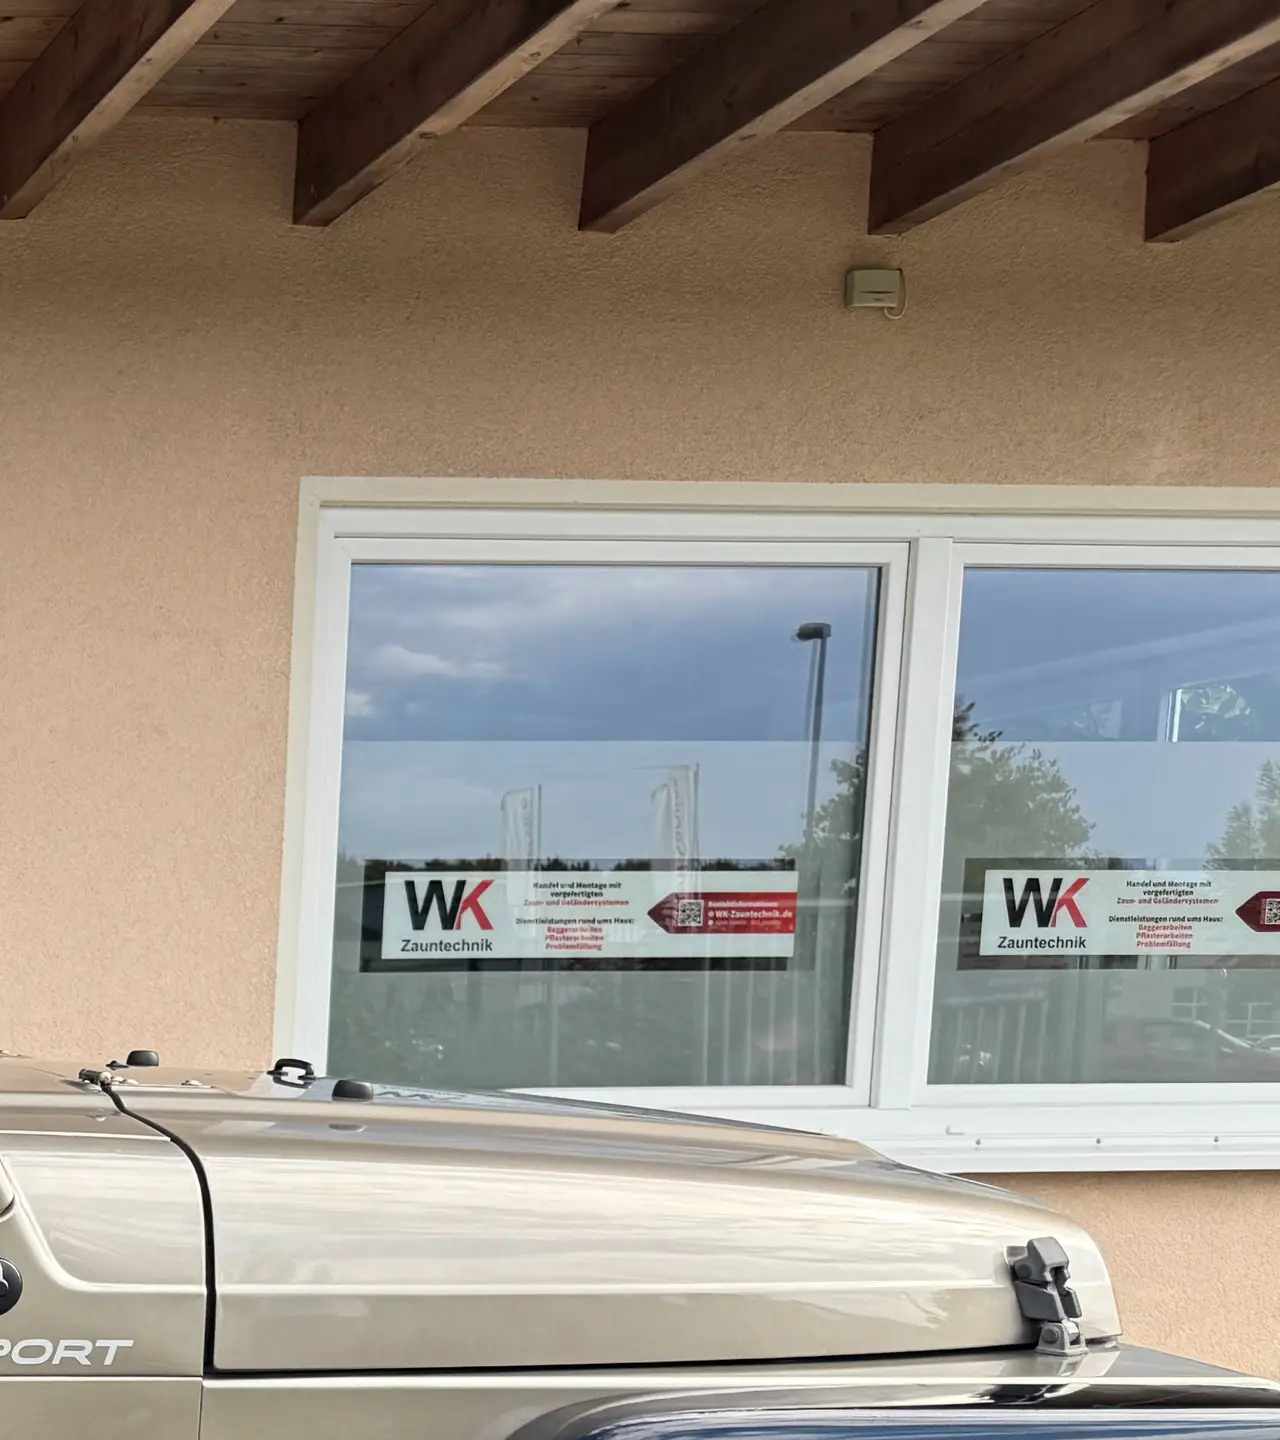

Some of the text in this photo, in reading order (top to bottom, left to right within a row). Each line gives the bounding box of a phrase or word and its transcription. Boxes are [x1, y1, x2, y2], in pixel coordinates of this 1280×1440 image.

[1199, 880, 1212, 888] mit
[404, 879, 495, 931] WK
[1002, 877, 1091, 928] WK
[401, 937, 493, 952] Zauntechnik
[997, 936, 1087, 950] Zauntechnik
